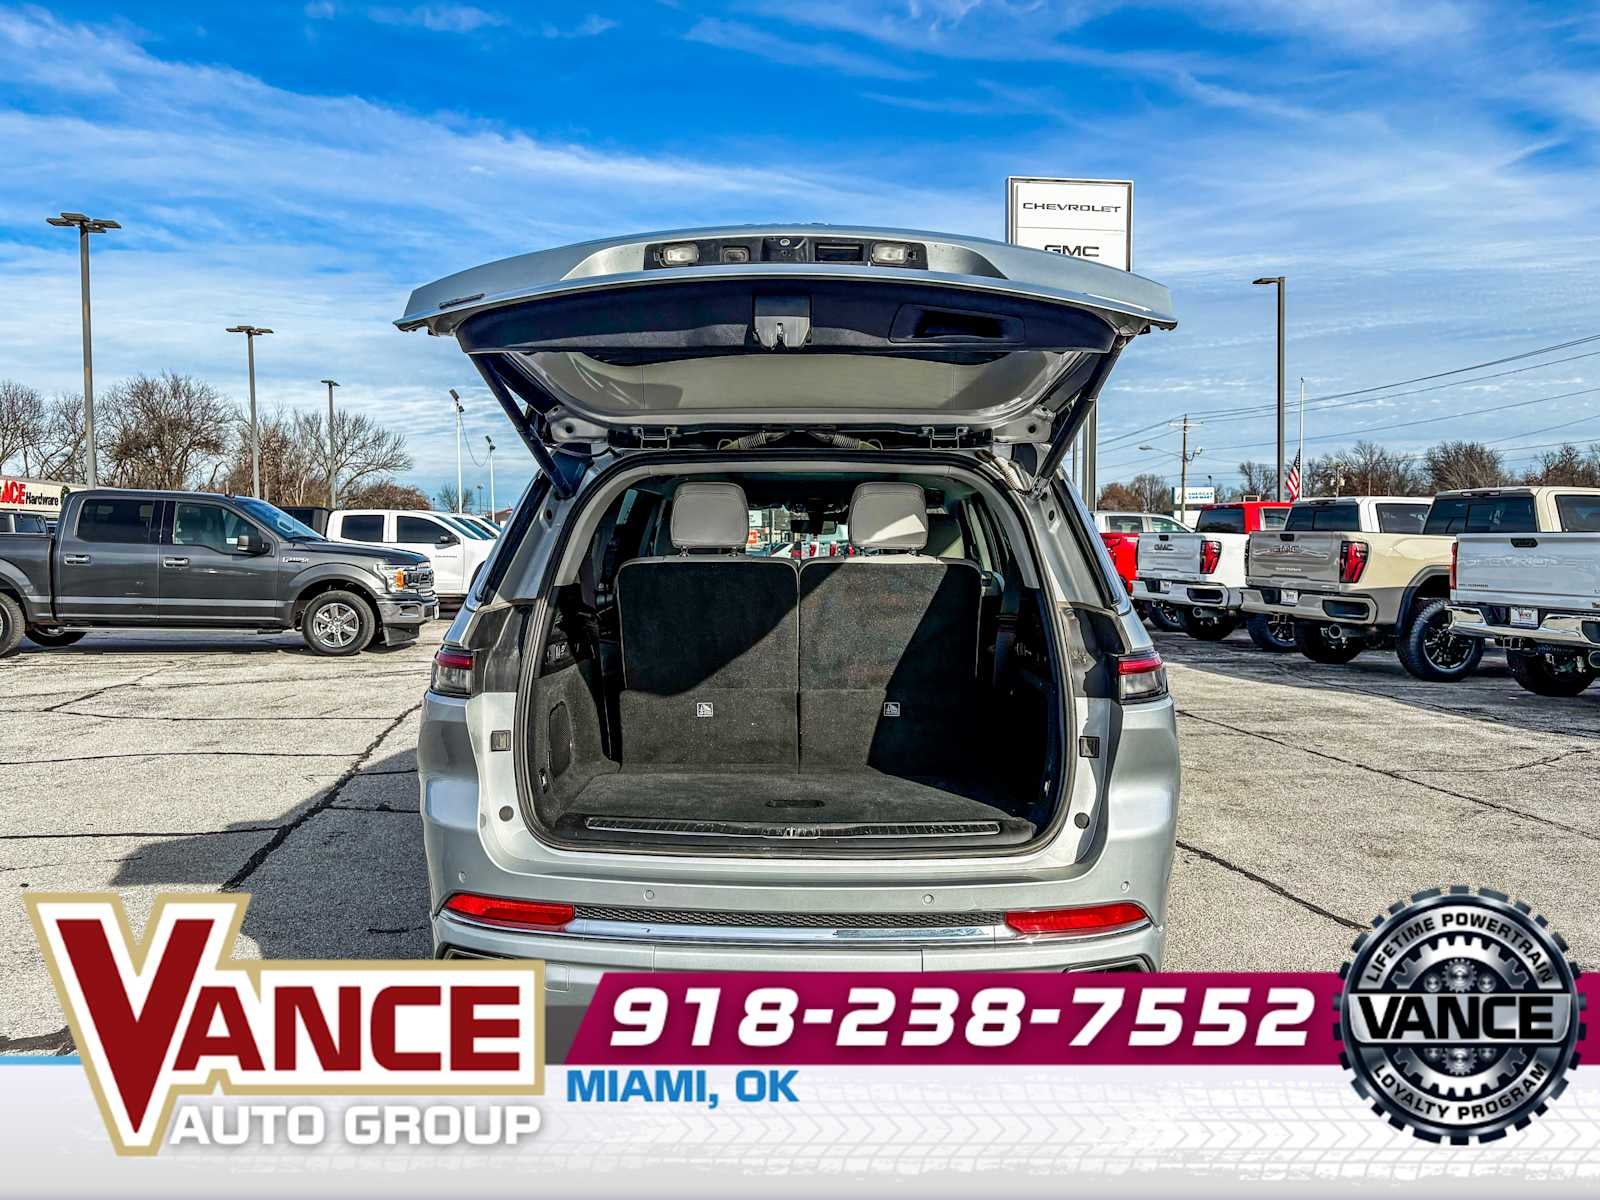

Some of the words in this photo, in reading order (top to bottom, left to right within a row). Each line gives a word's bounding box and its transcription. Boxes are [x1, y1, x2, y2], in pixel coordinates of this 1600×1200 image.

[1022, 202, 1121, 213] CHEVROLET
[1044, 244, 1100, 258] GMC
[0, 480, 26, 504] ACE
[26, 492, 59, 506] Hardware
